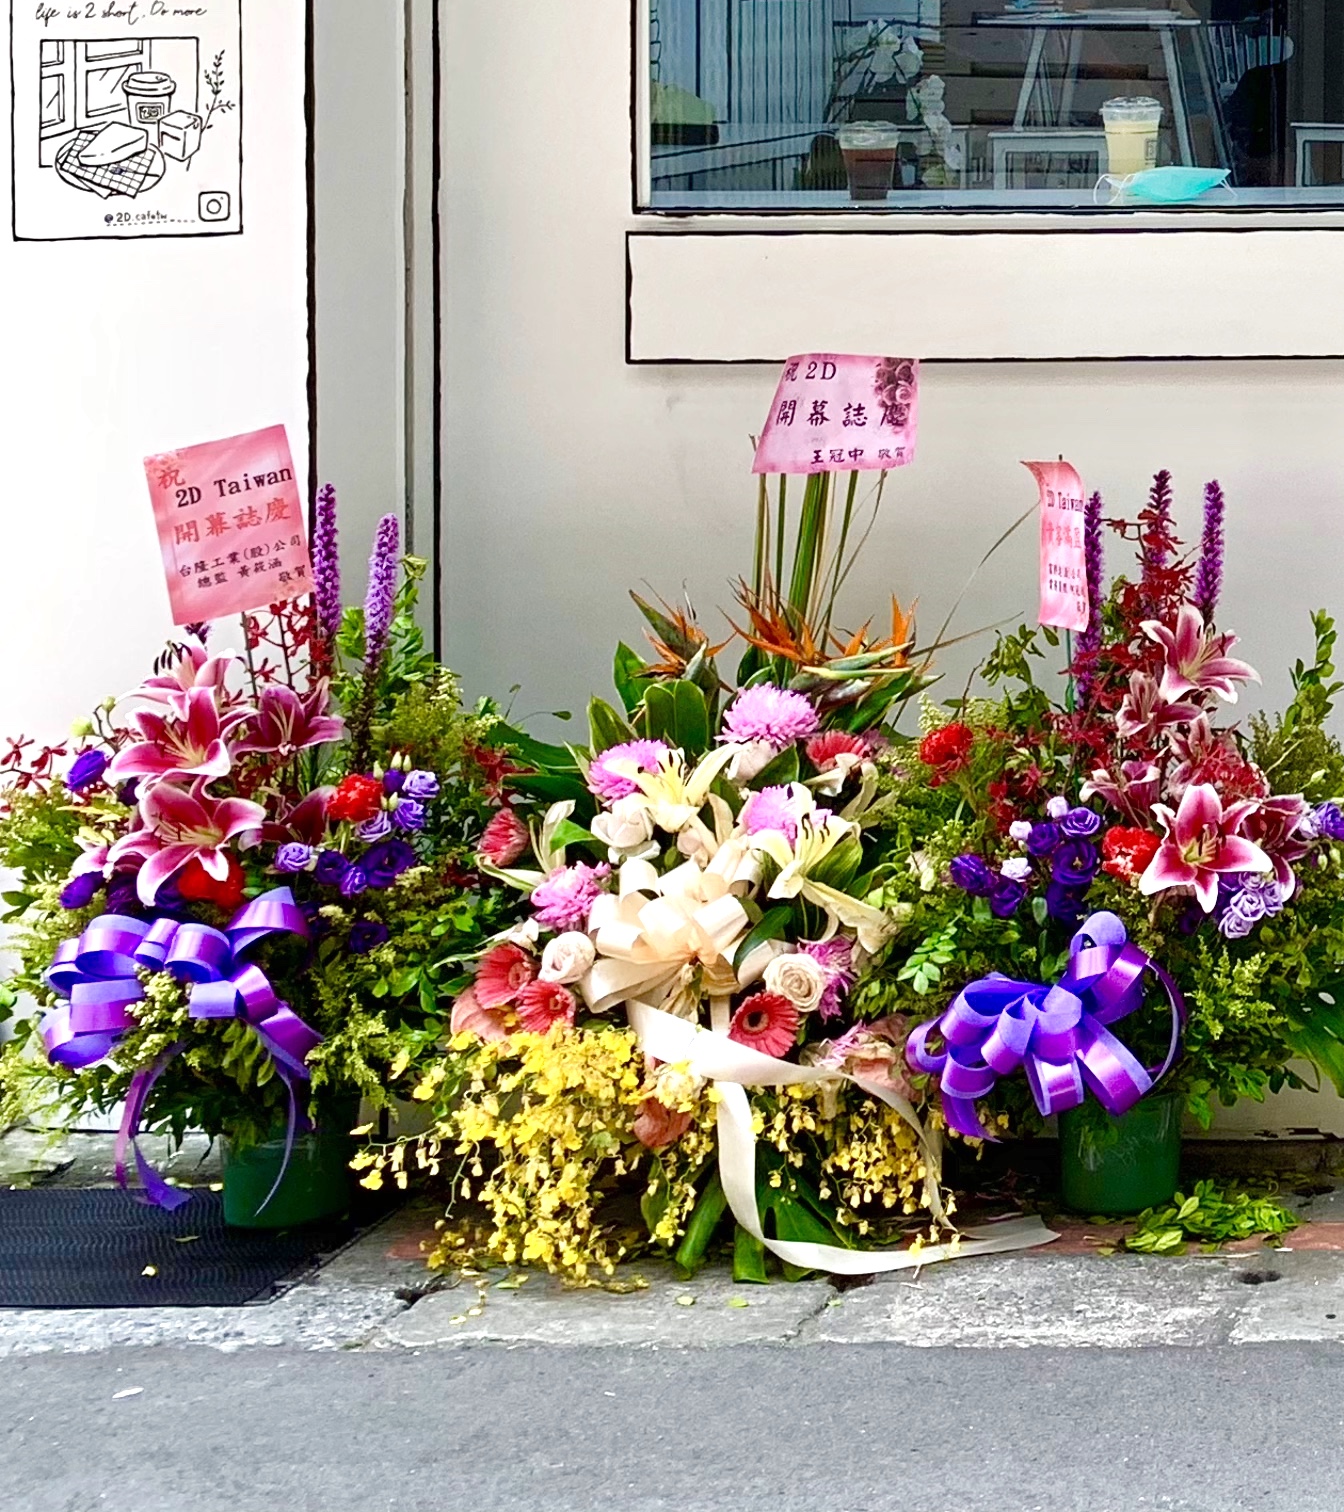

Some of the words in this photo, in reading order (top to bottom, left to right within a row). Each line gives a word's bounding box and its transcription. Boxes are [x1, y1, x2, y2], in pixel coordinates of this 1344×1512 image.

[35, 2, 60, 27] life
[67, 7, 81, 19] is
[84, 2, 97, 19] 2
[172, 7, 207, 16] more
[805, 361, 837, 380] 2D
[776, 399, 909, 427] 開幕誌慶
[158, 469, 185, 489] 祝
[175, 487, 201, 507] 2D
[214, 467, 292, 497] Taiwan
[174, 498, 291, 545] 開幕誌慶
